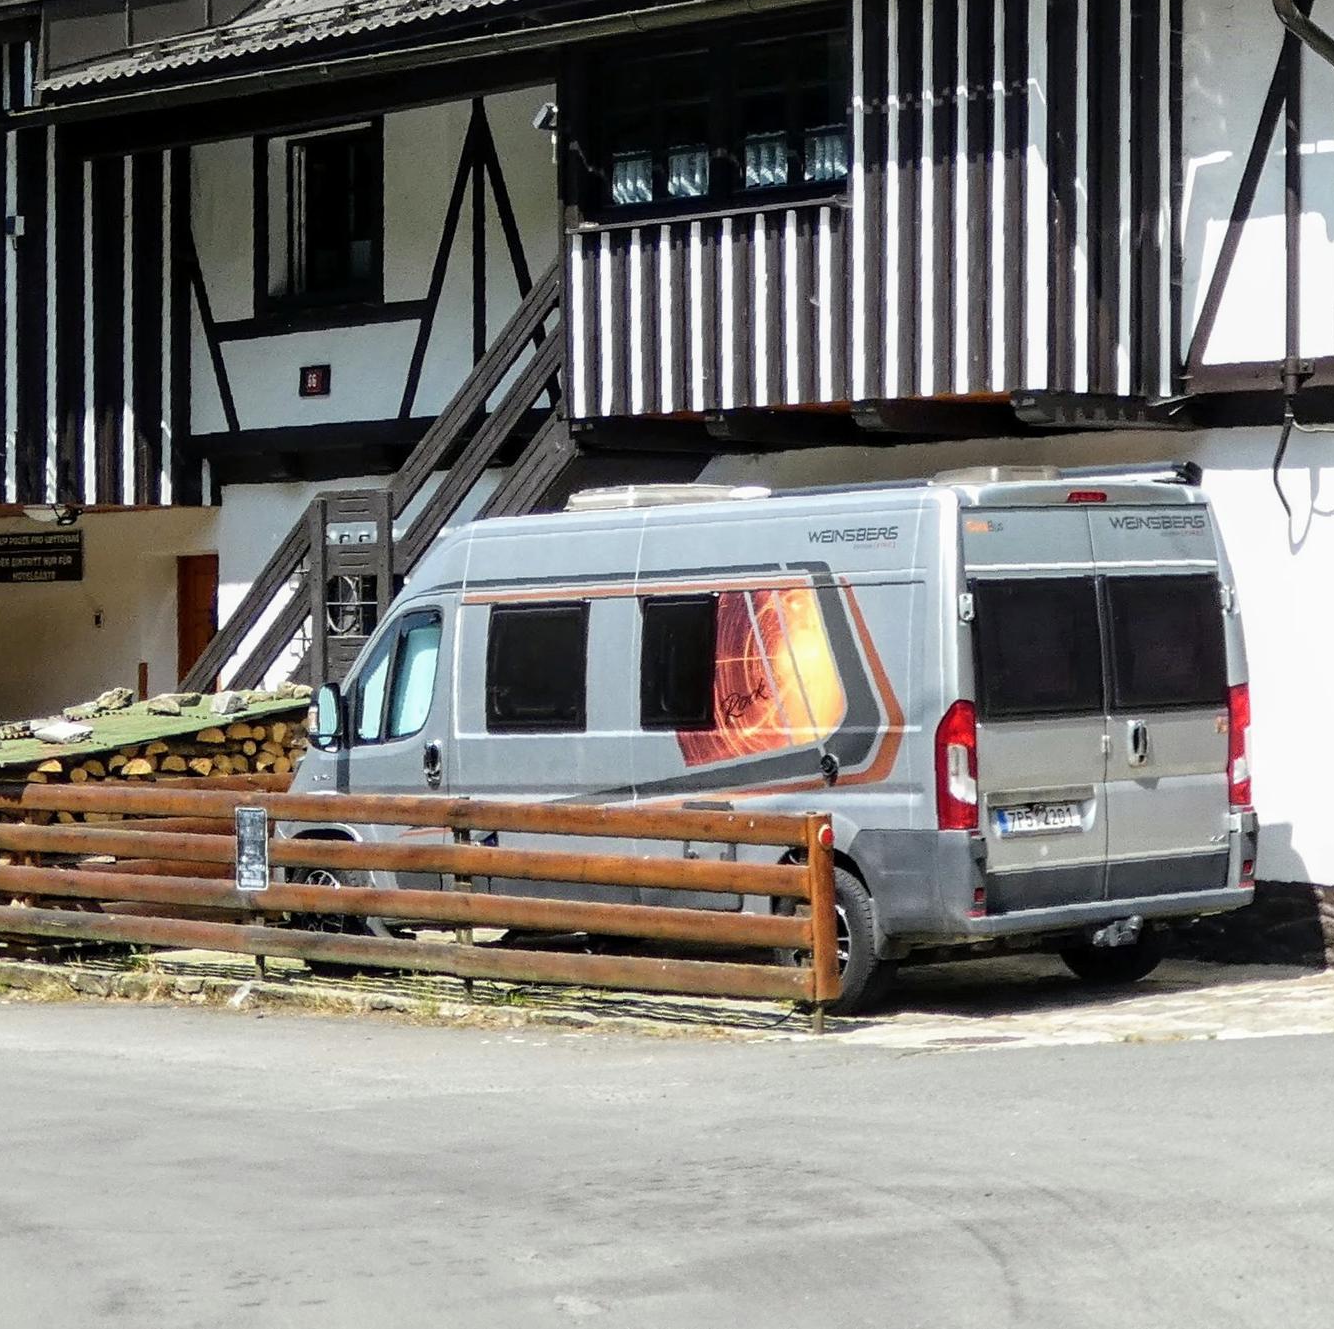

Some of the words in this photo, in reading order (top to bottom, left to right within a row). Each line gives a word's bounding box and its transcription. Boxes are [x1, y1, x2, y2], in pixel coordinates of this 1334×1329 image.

[1108, 515, 1205, 530] WEINSBERG
[808, 526, 898, 543] WEINSBERG
[11, 557, 42, 567] EINTRITT
[43, 556, 57, 566] NUR
[58, 554, 72, 565] FÜR
